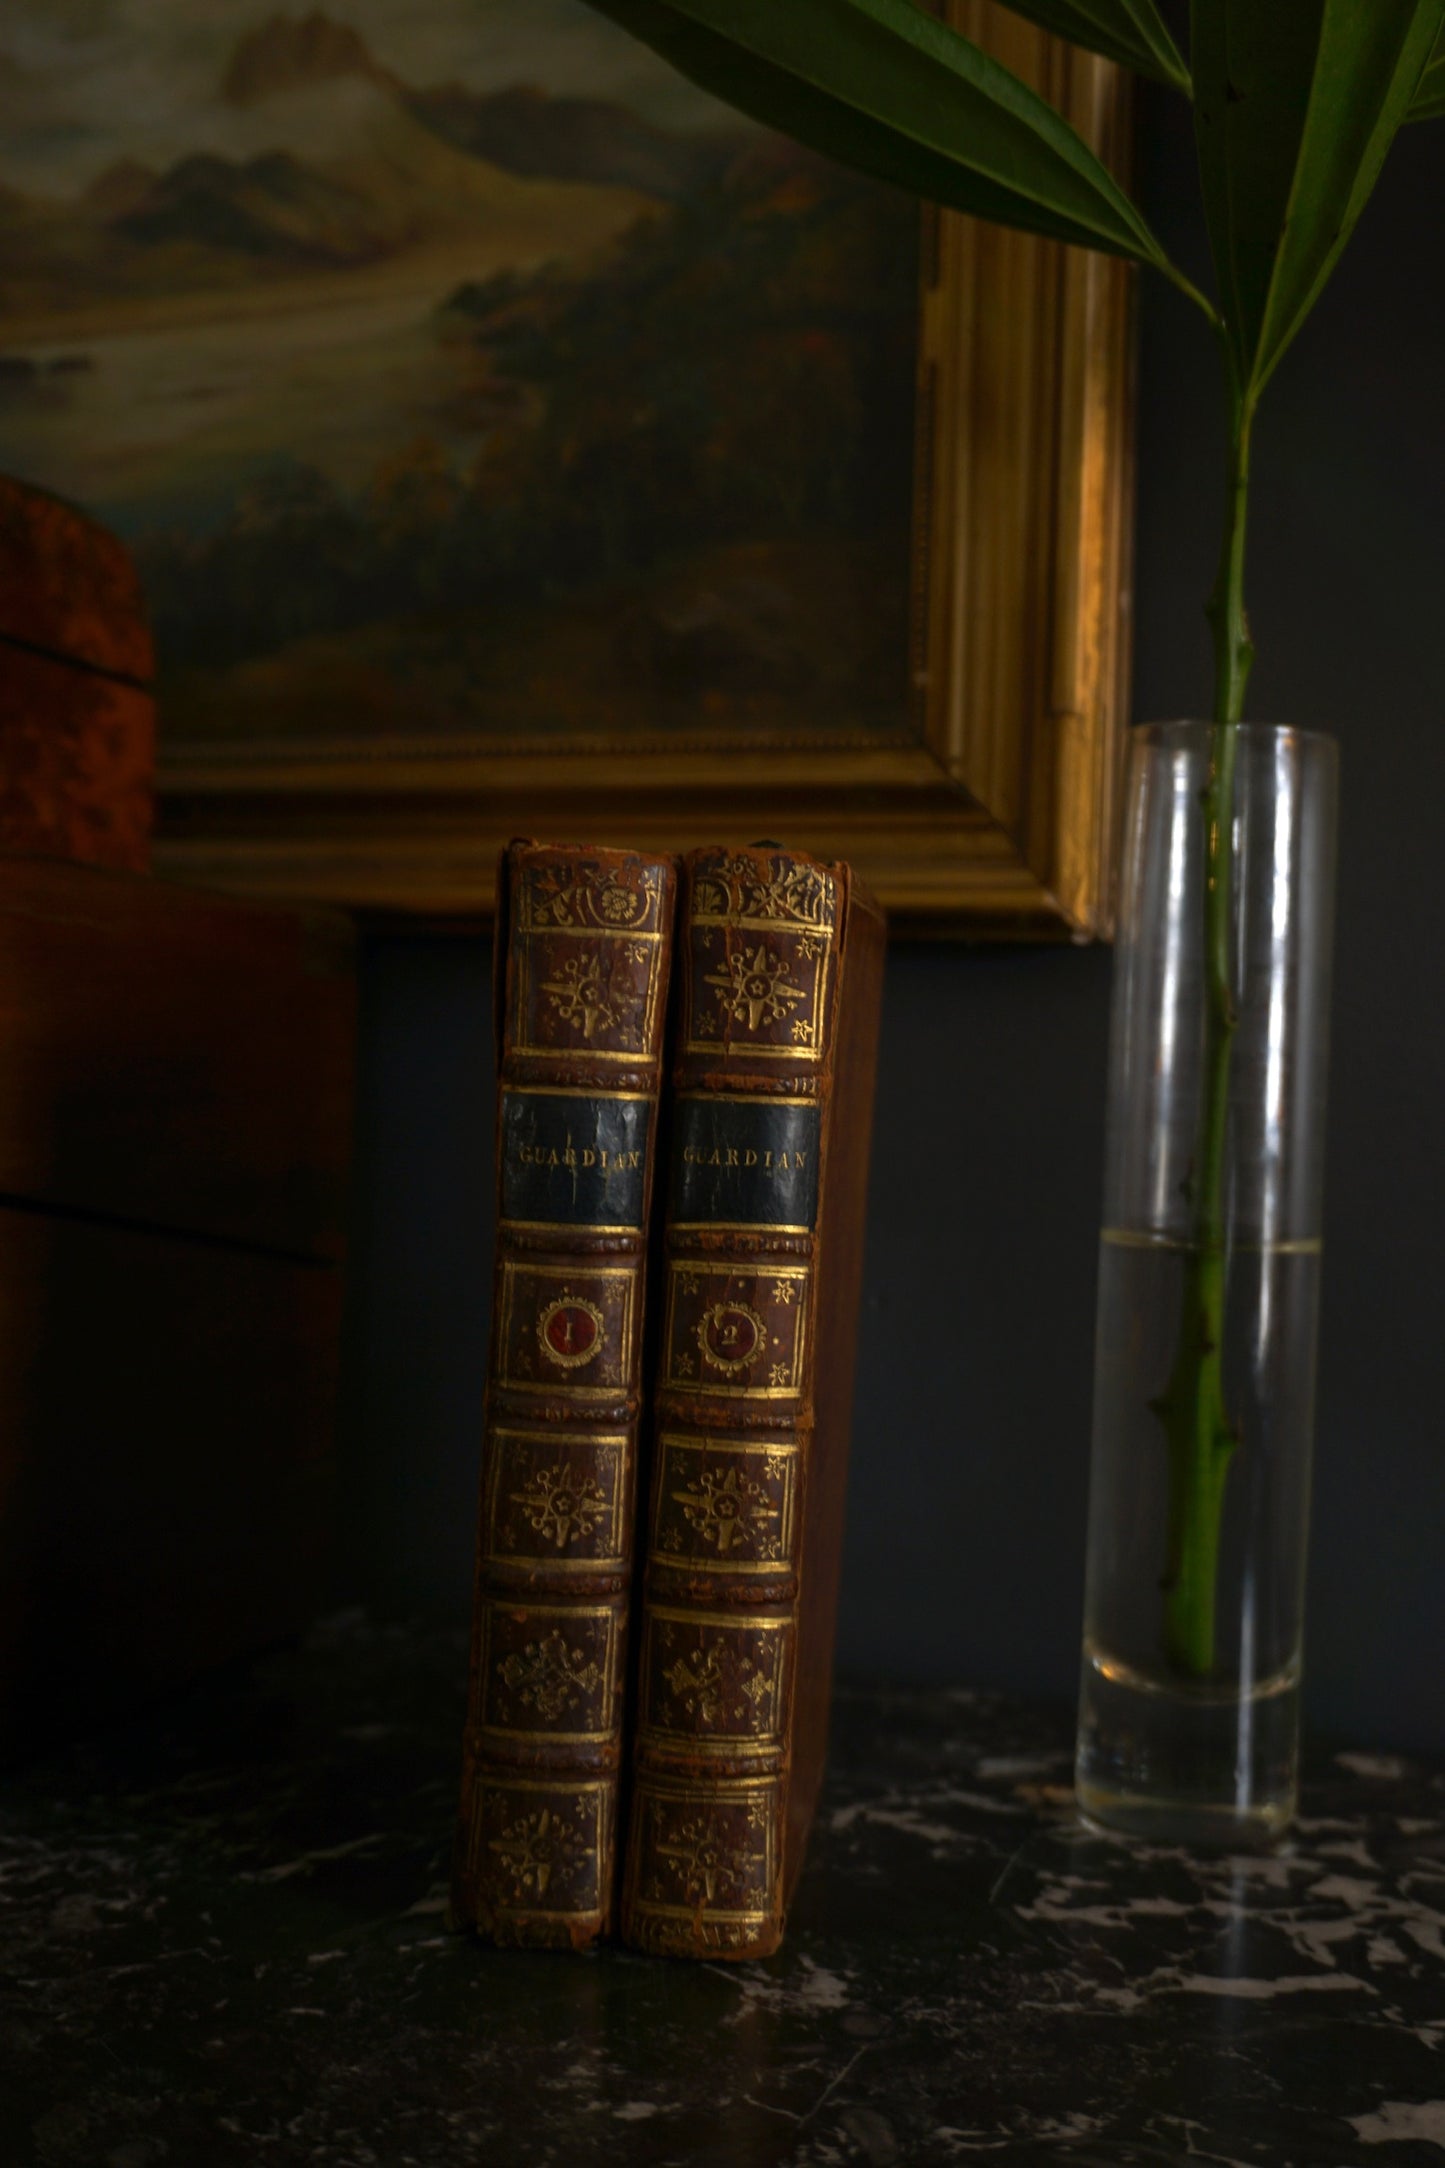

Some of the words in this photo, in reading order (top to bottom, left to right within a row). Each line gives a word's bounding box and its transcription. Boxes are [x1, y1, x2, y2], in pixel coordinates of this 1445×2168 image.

[518, 1146, 641, 1169] GUARDIAN
[682, 1147, 808, 1169] GUARDIAN
[721, 1324, 739, 1346] 2
